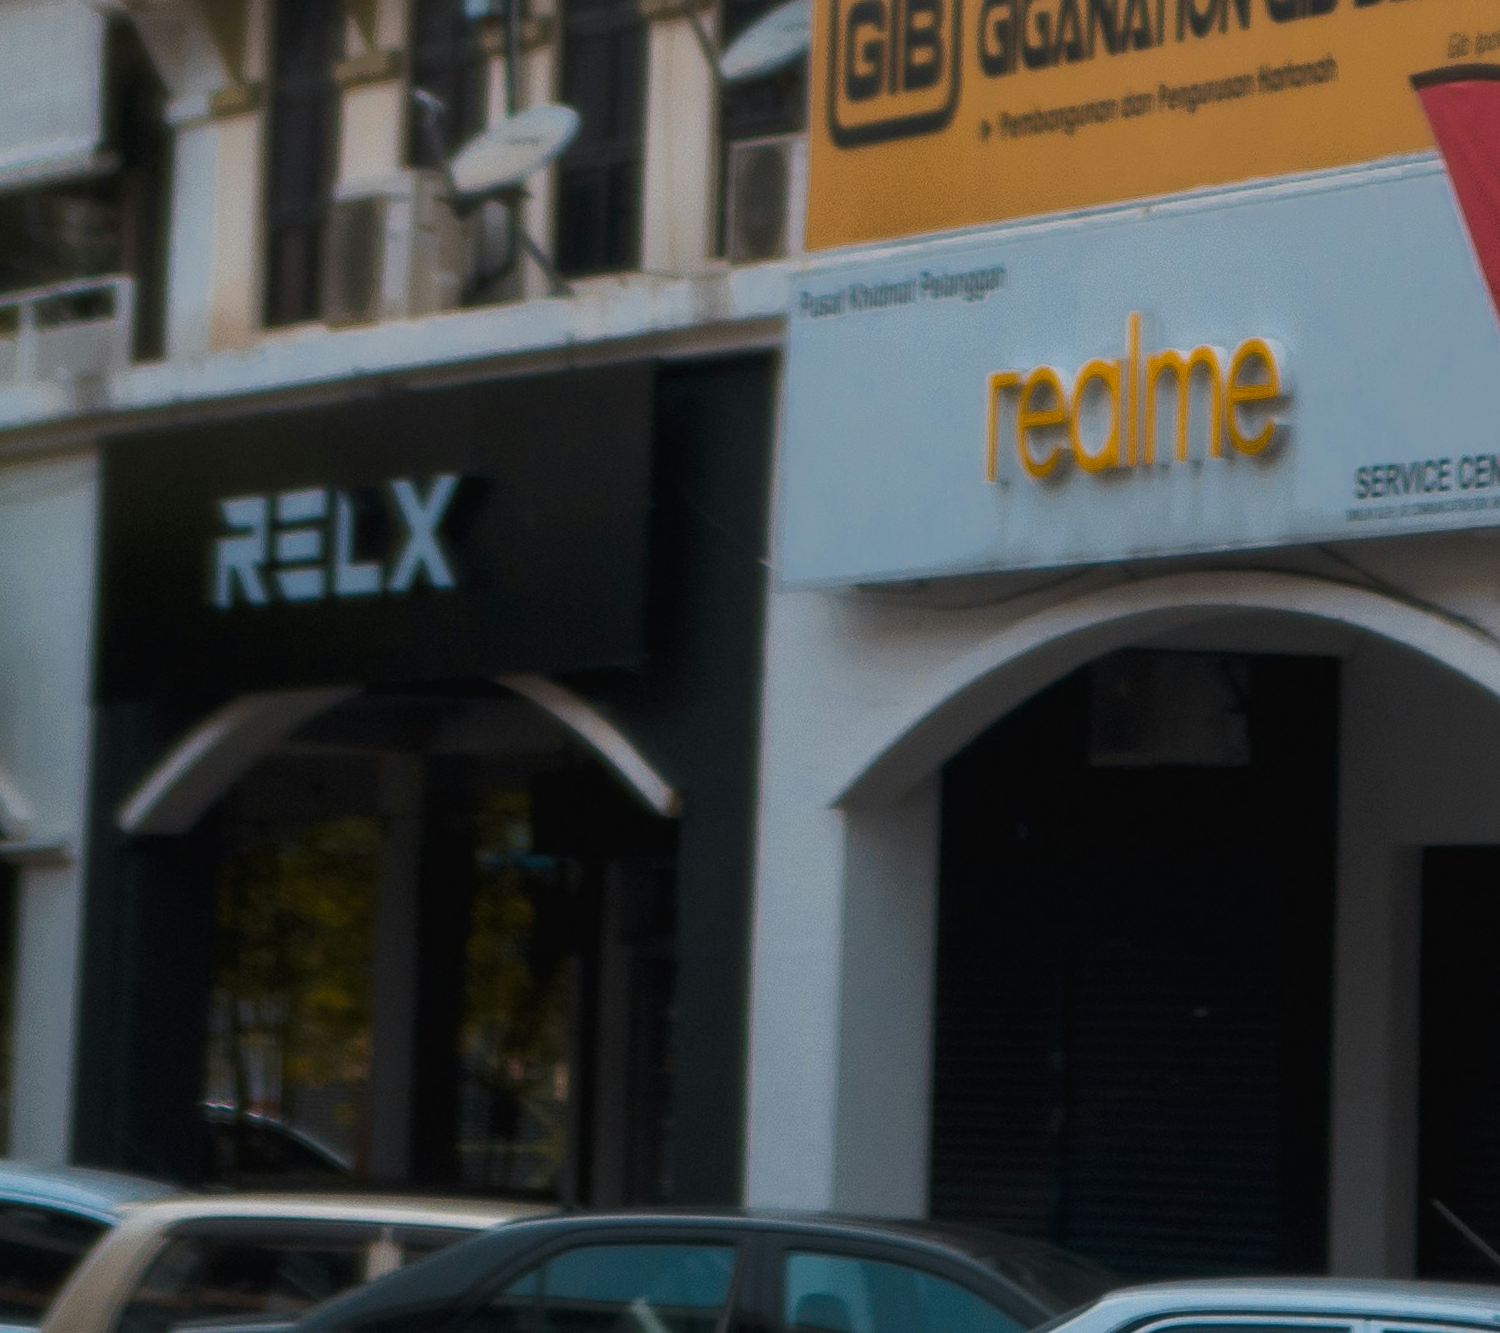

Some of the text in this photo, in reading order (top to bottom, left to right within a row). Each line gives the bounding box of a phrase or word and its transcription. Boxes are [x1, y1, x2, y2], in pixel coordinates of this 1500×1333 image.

[985, 311, 1284, 484] realme
[214, 474, 460, 609] RELX
[1356, 458, 1450, 499] SERVICE
